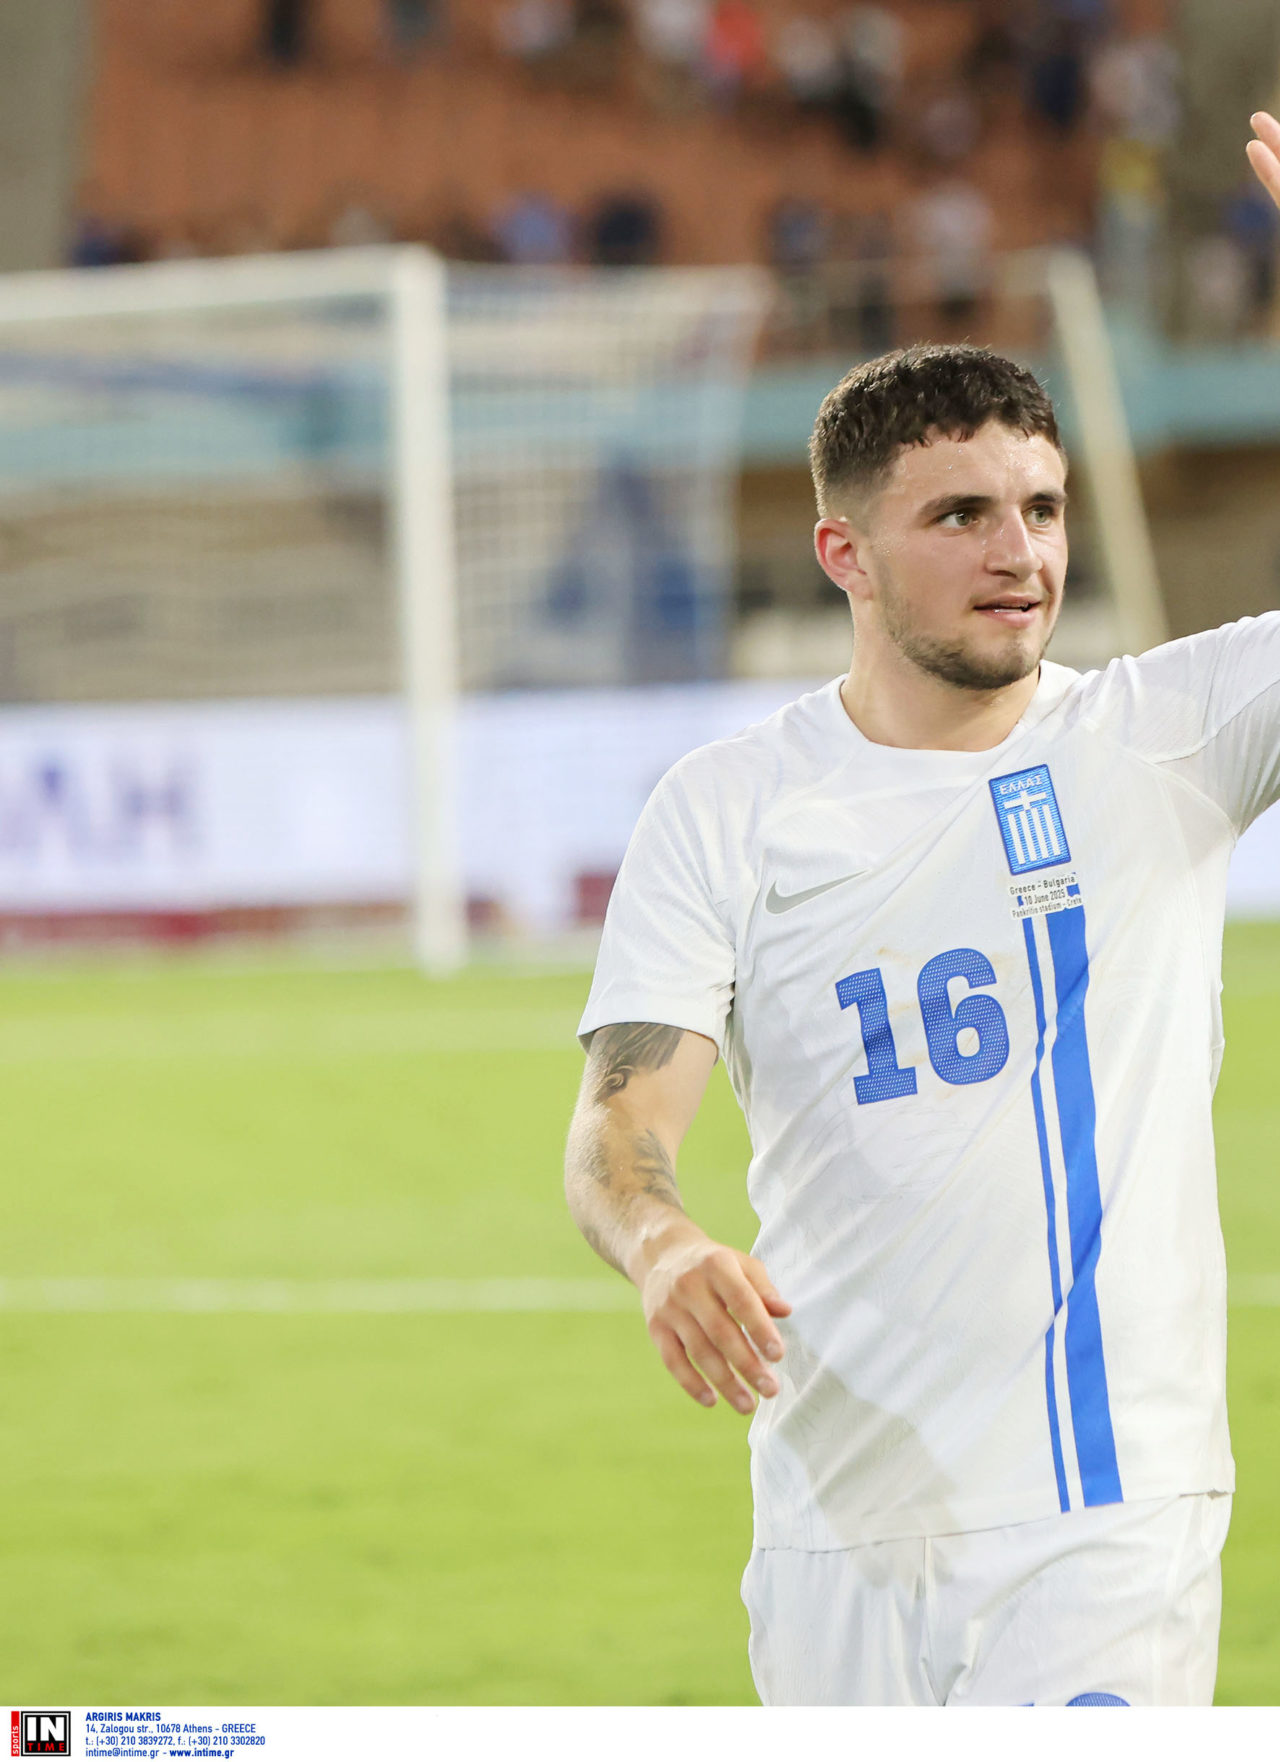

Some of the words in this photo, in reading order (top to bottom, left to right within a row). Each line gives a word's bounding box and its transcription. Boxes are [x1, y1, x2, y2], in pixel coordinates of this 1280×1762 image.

[999, 774, 1043, 795] ΕΛΛΑΣ
[1009, 884, 1036, 895] Greece
[1042, 876, 1076, 889] Bulgaria
[1023, 894, 1033, 906] 10
[1034, 892, 1049, 904] June
[1049, 888, 1066, 901] 2025
[1039, 901, 1062, 913] stadium
[1066, 896, 1082, 907] Crete
[835, 948, 1010, 1105] 16
